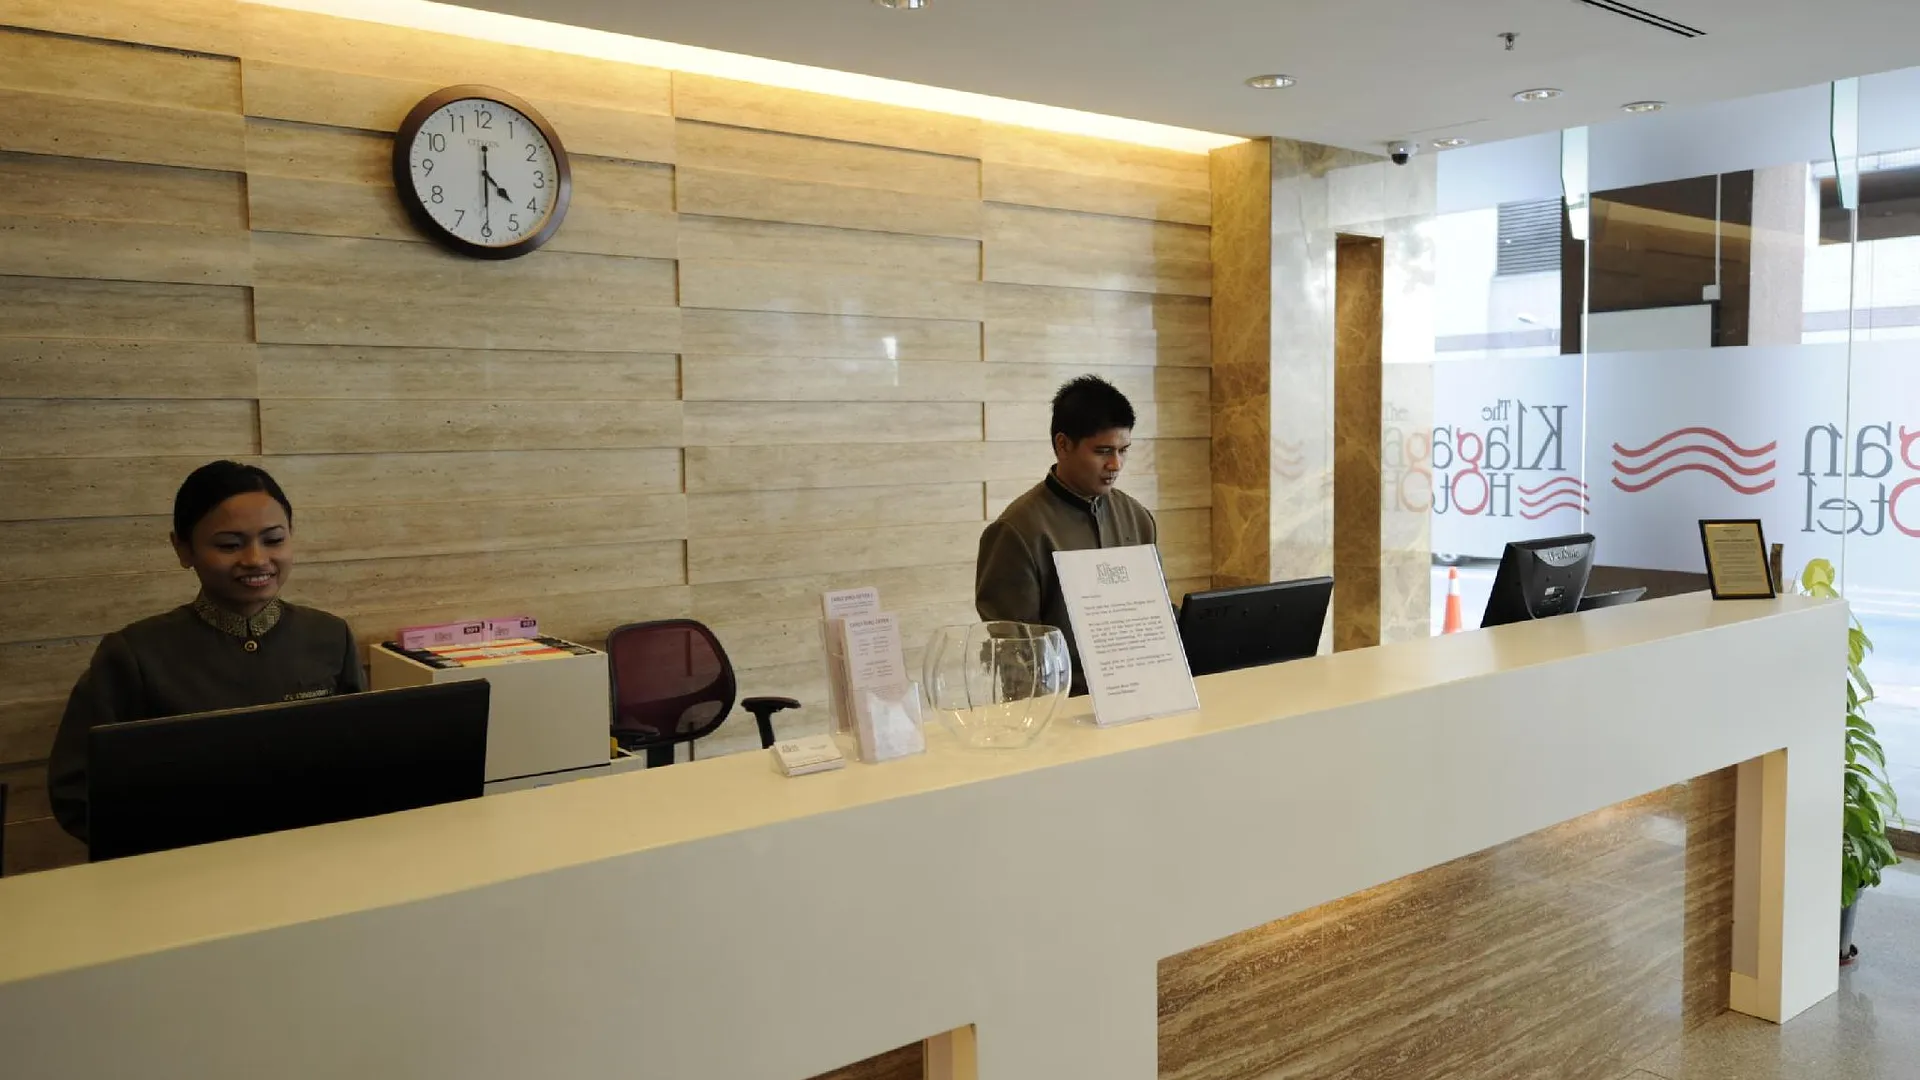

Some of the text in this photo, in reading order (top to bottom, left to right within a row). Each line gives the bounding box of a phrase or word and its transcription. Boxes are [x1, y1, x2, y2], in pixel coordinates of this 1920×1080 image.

[450, 114, 465, 133] 11
[474, 109, 493, 130] 12
[508, 121, 514, 140] 1
[427, 133, 446, 153] 10
[525, 144, 538, 163] 2
[422, 158, 434, 178] 9
[532, 170, 545, 189] 3
[431, 185, 444, 205] 8
[526, 197, 538, 214] 4
[454, 209, 466, 228] 7
[507, 213, 520, 232] 5
[480, 221, 493, 238] 6
